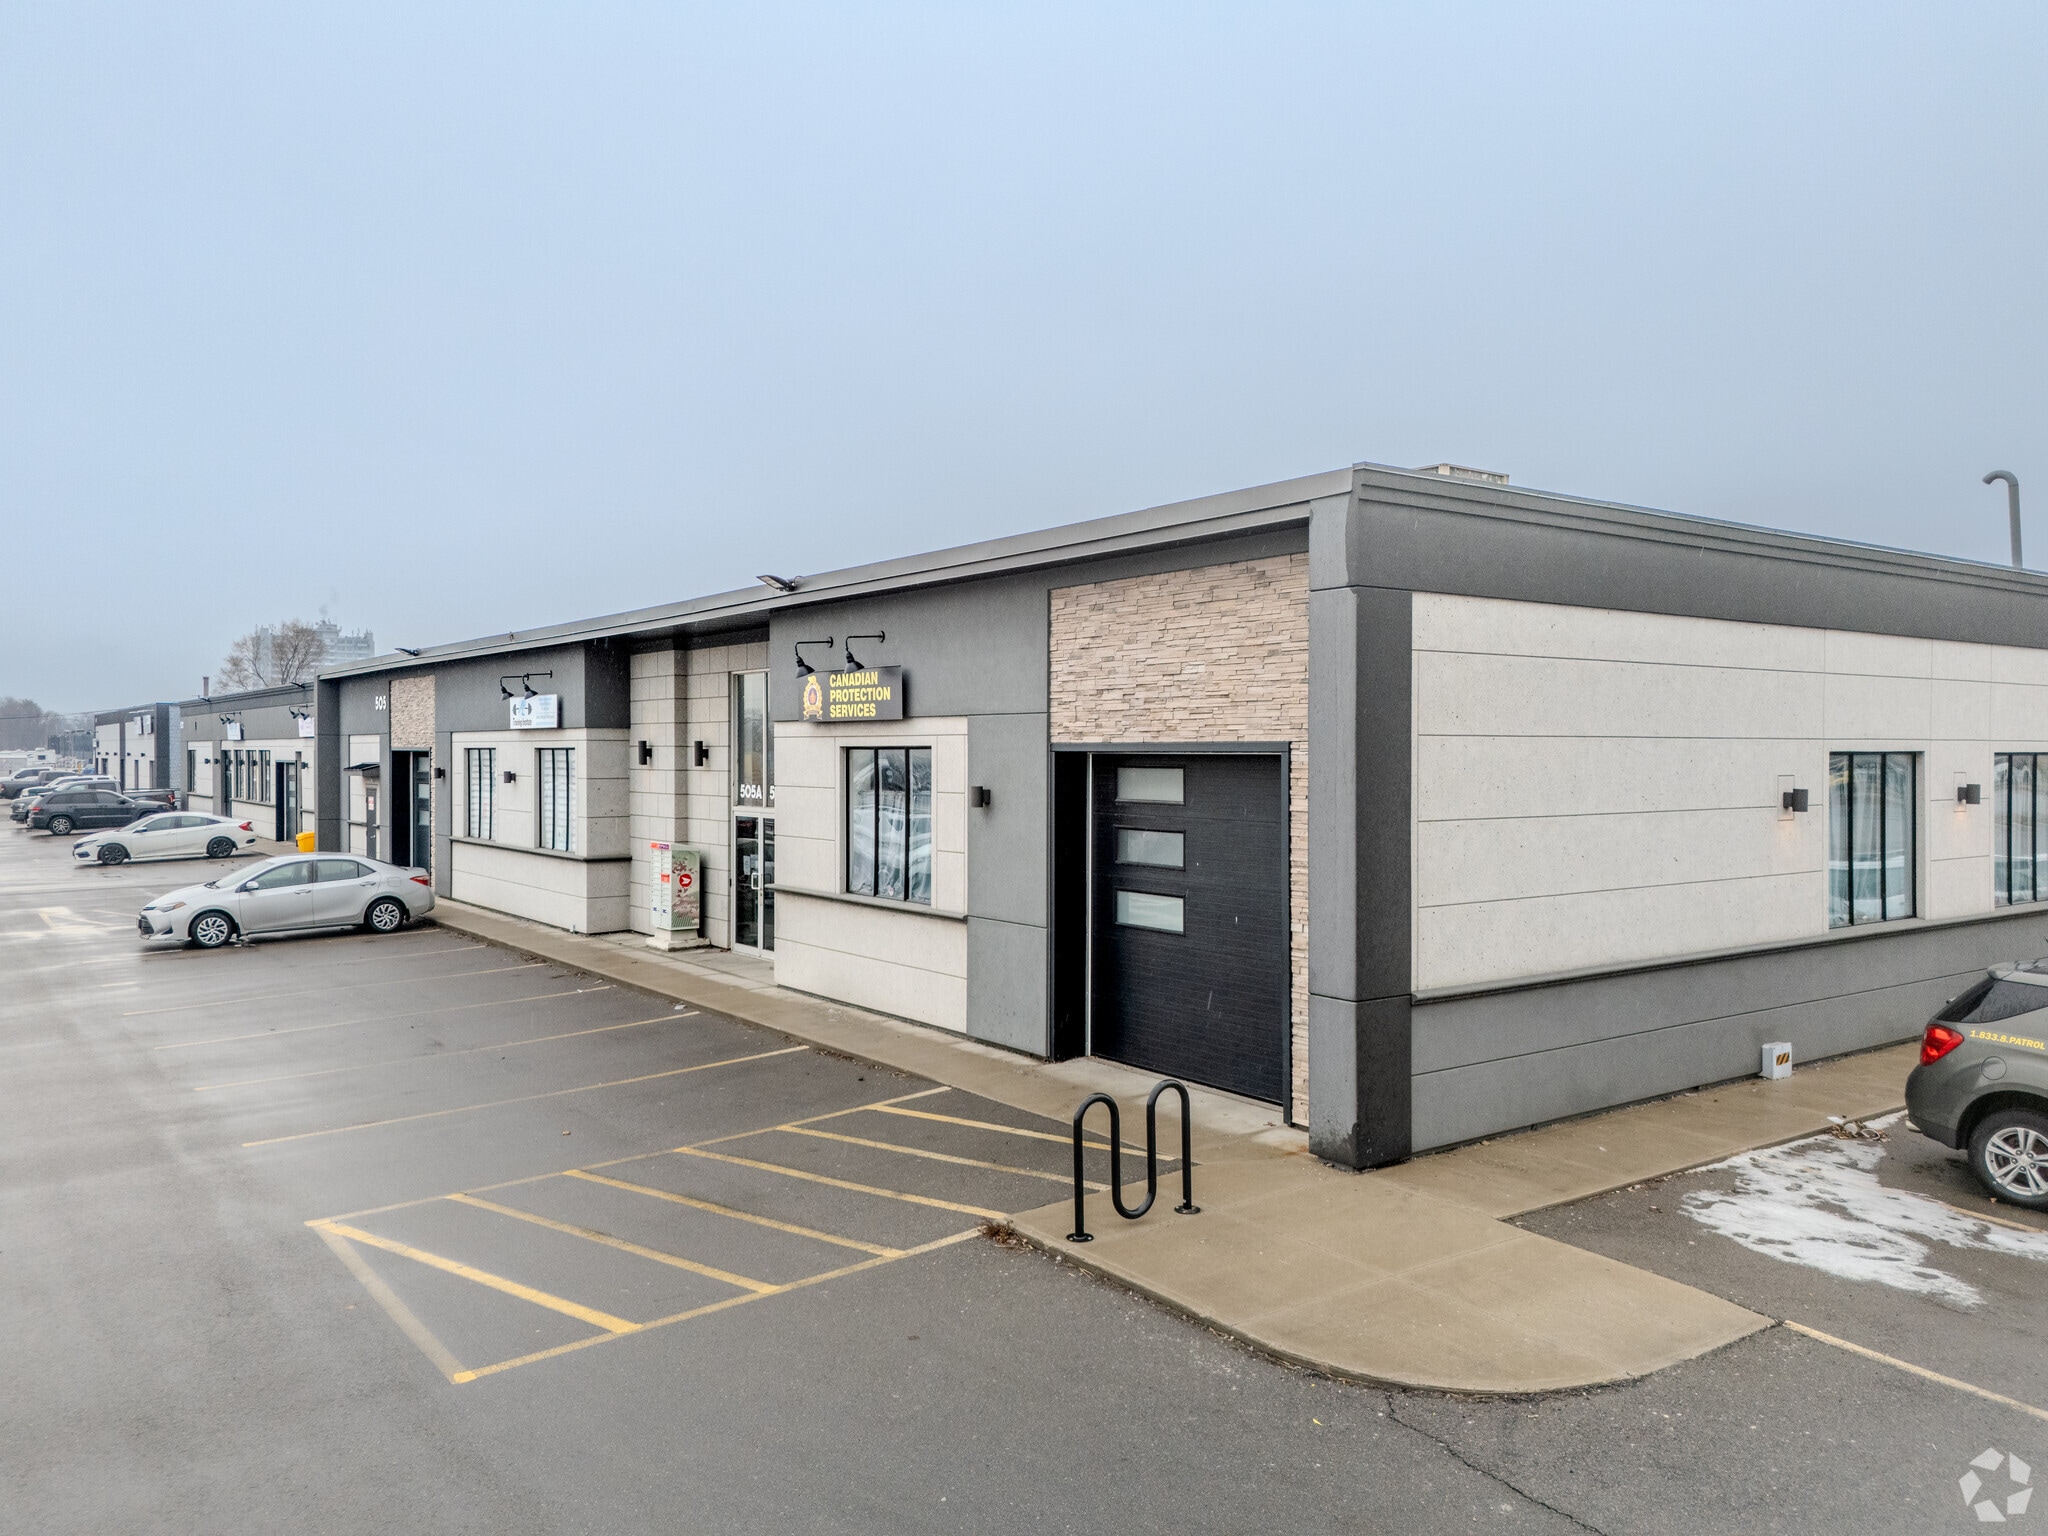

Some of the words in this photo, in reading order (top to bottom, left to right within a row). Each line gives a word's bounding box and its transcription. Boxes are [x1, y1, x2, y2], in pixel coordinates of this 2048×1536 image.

[829, 671, 878, 687] CANADIAN
[829, 686, 891, 702] PROTECTION
[375, 695, 386, 710] 505
[829, 703, 876, 718] SERVICES
[740, 784, 762, 799] 505A
[1969, 1029, 2046, 1050] 1.833.8.PATROL
